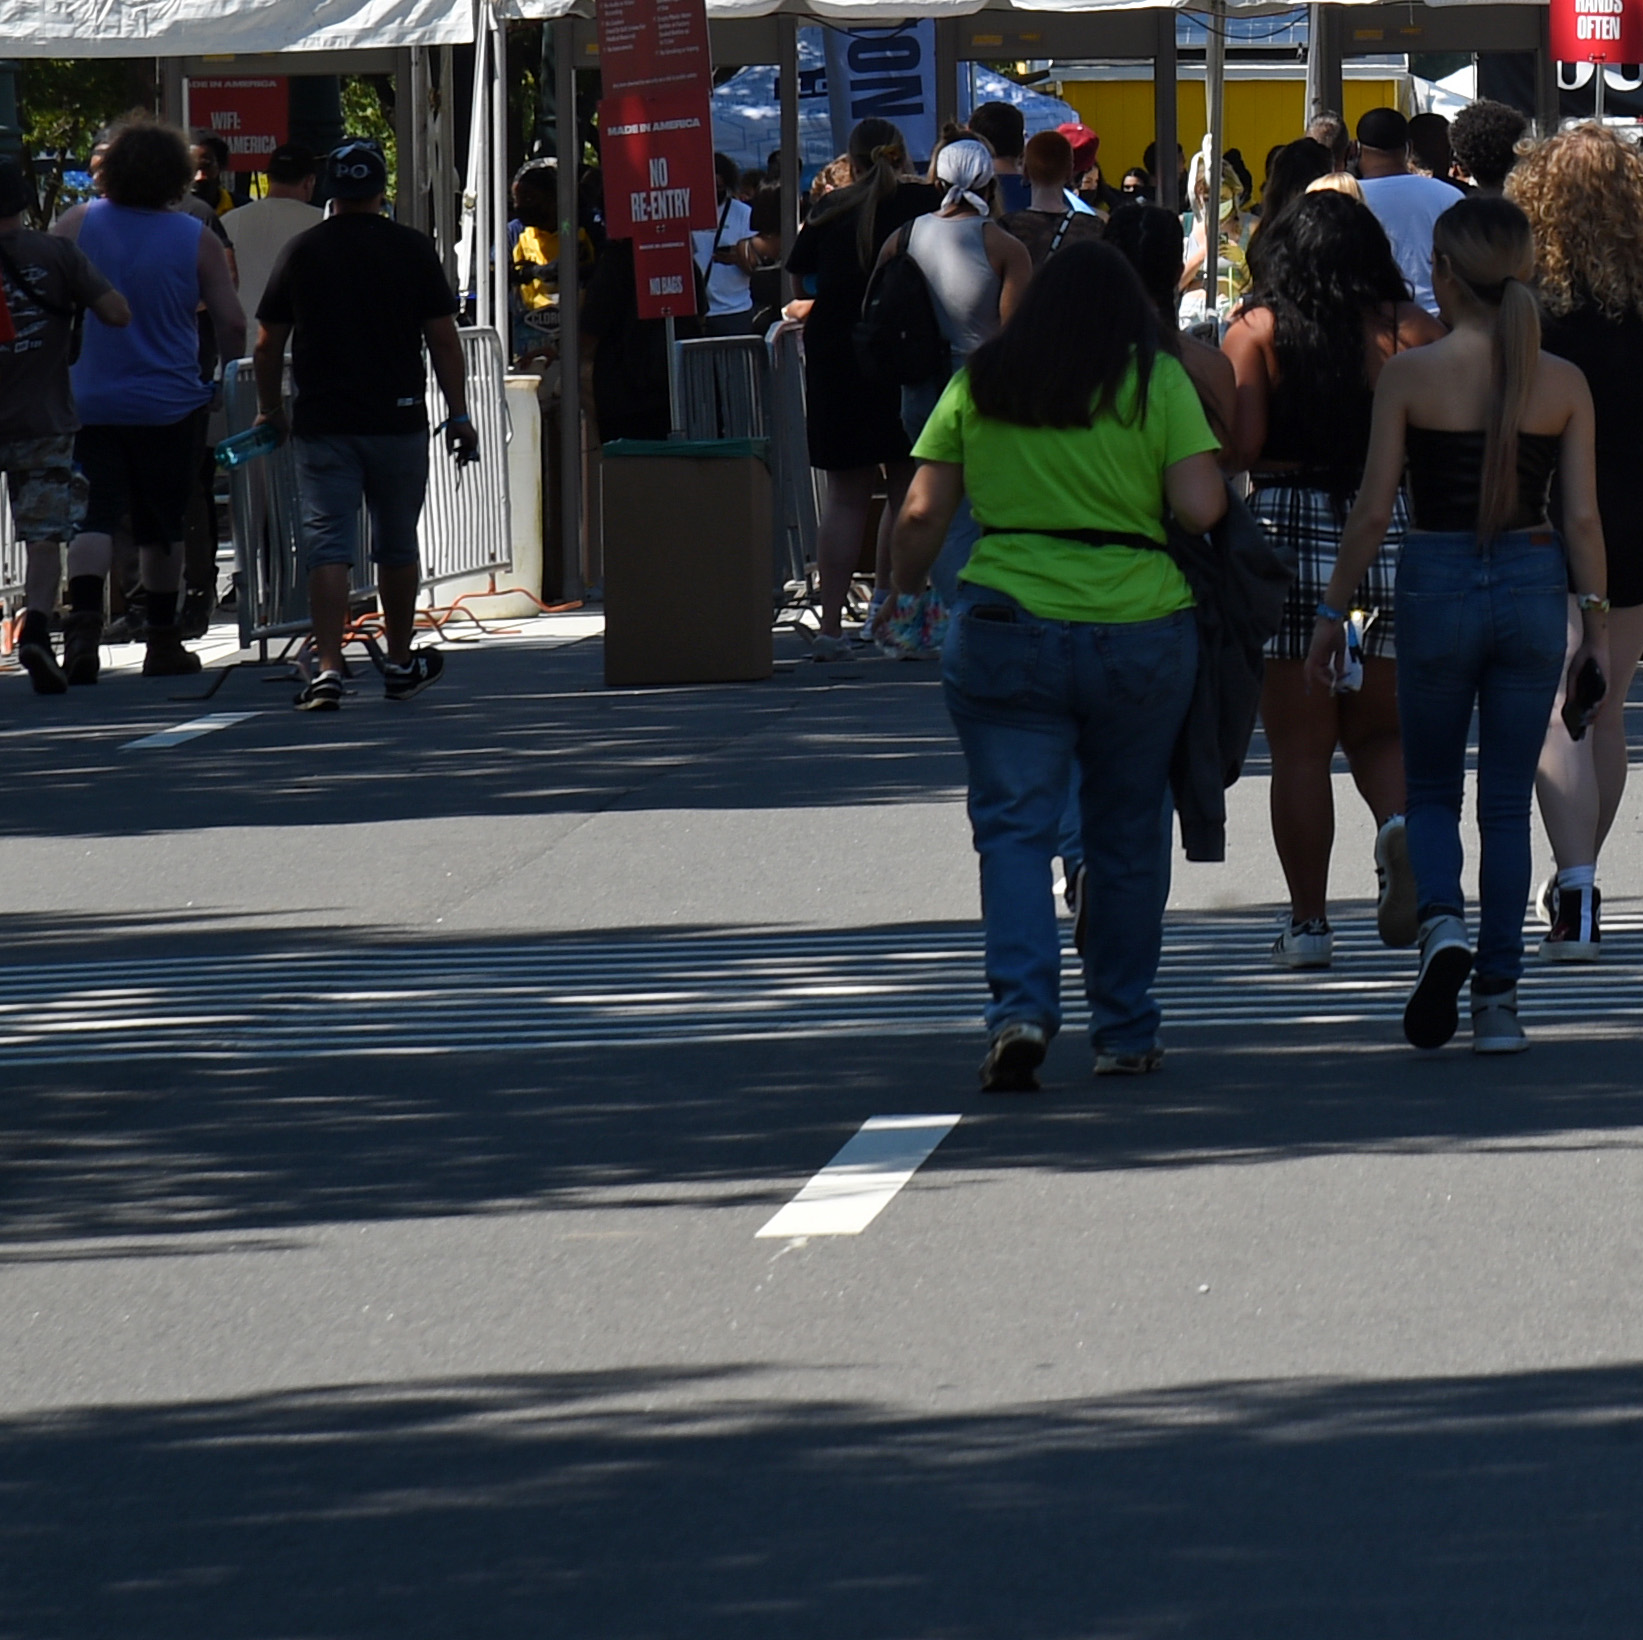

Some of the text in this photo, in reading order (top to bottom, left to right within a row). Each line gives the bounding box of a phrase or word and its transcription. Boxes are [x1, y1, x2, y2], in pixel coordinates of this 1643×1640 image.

[1576, 16, 1621, 40] OFTEN
[226, 80, 278, 88] AMERICA
[210, 112, 241, 130] WIFI:
[608, 118, 700, 136] MADE IN AMERICA
[649, 158, 668, 188] NO
[630, 188, 690, 223] RE-ENTRY
[650, 276, 683, 296] NO BAGS
